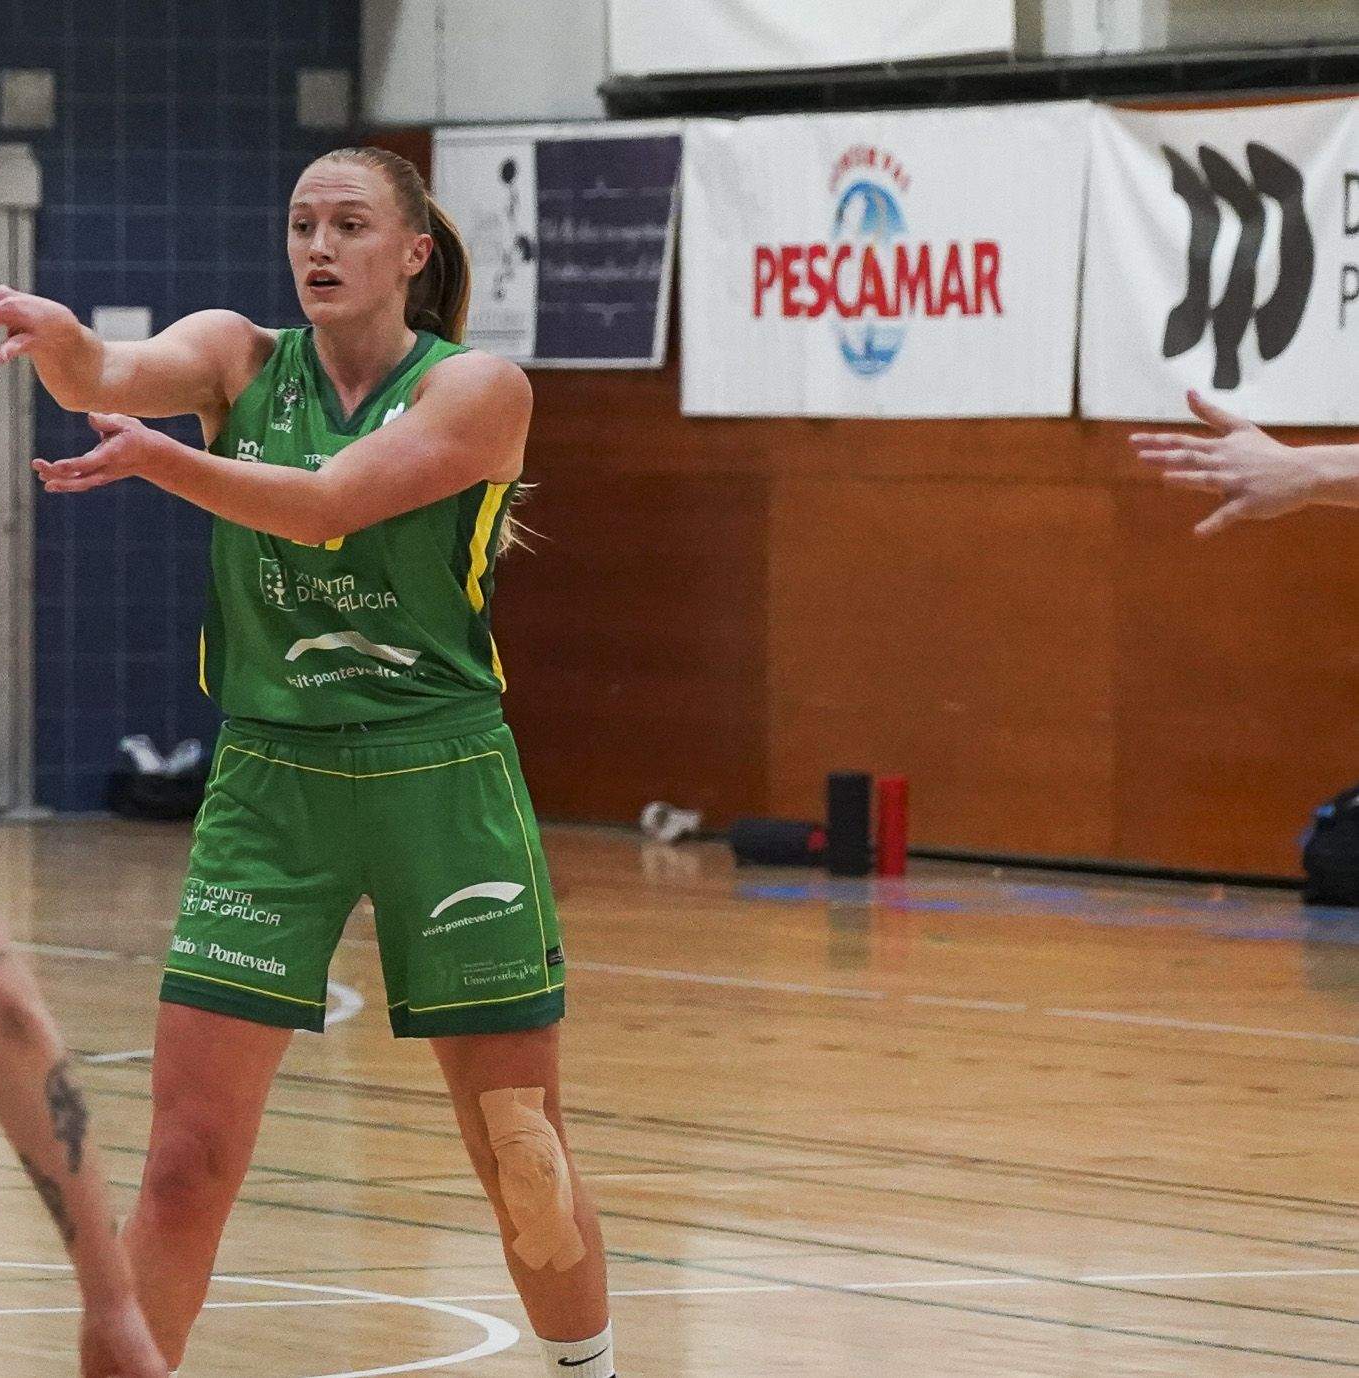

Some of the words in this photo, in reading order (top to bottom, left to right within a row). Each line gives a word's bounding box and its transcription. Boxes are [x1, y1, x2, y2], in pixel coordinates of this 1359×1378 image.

[752, 241, 1004, 318] PESCAMAR
[205, 884, 253, 905] XUNTA
[199, 900, 219, 914] DE
[219, 903, 282, 926] GALICIA
[422, 902, 524, 937] visit-pontevedra.com
[207, 943, 287, 976] Pontevedra
